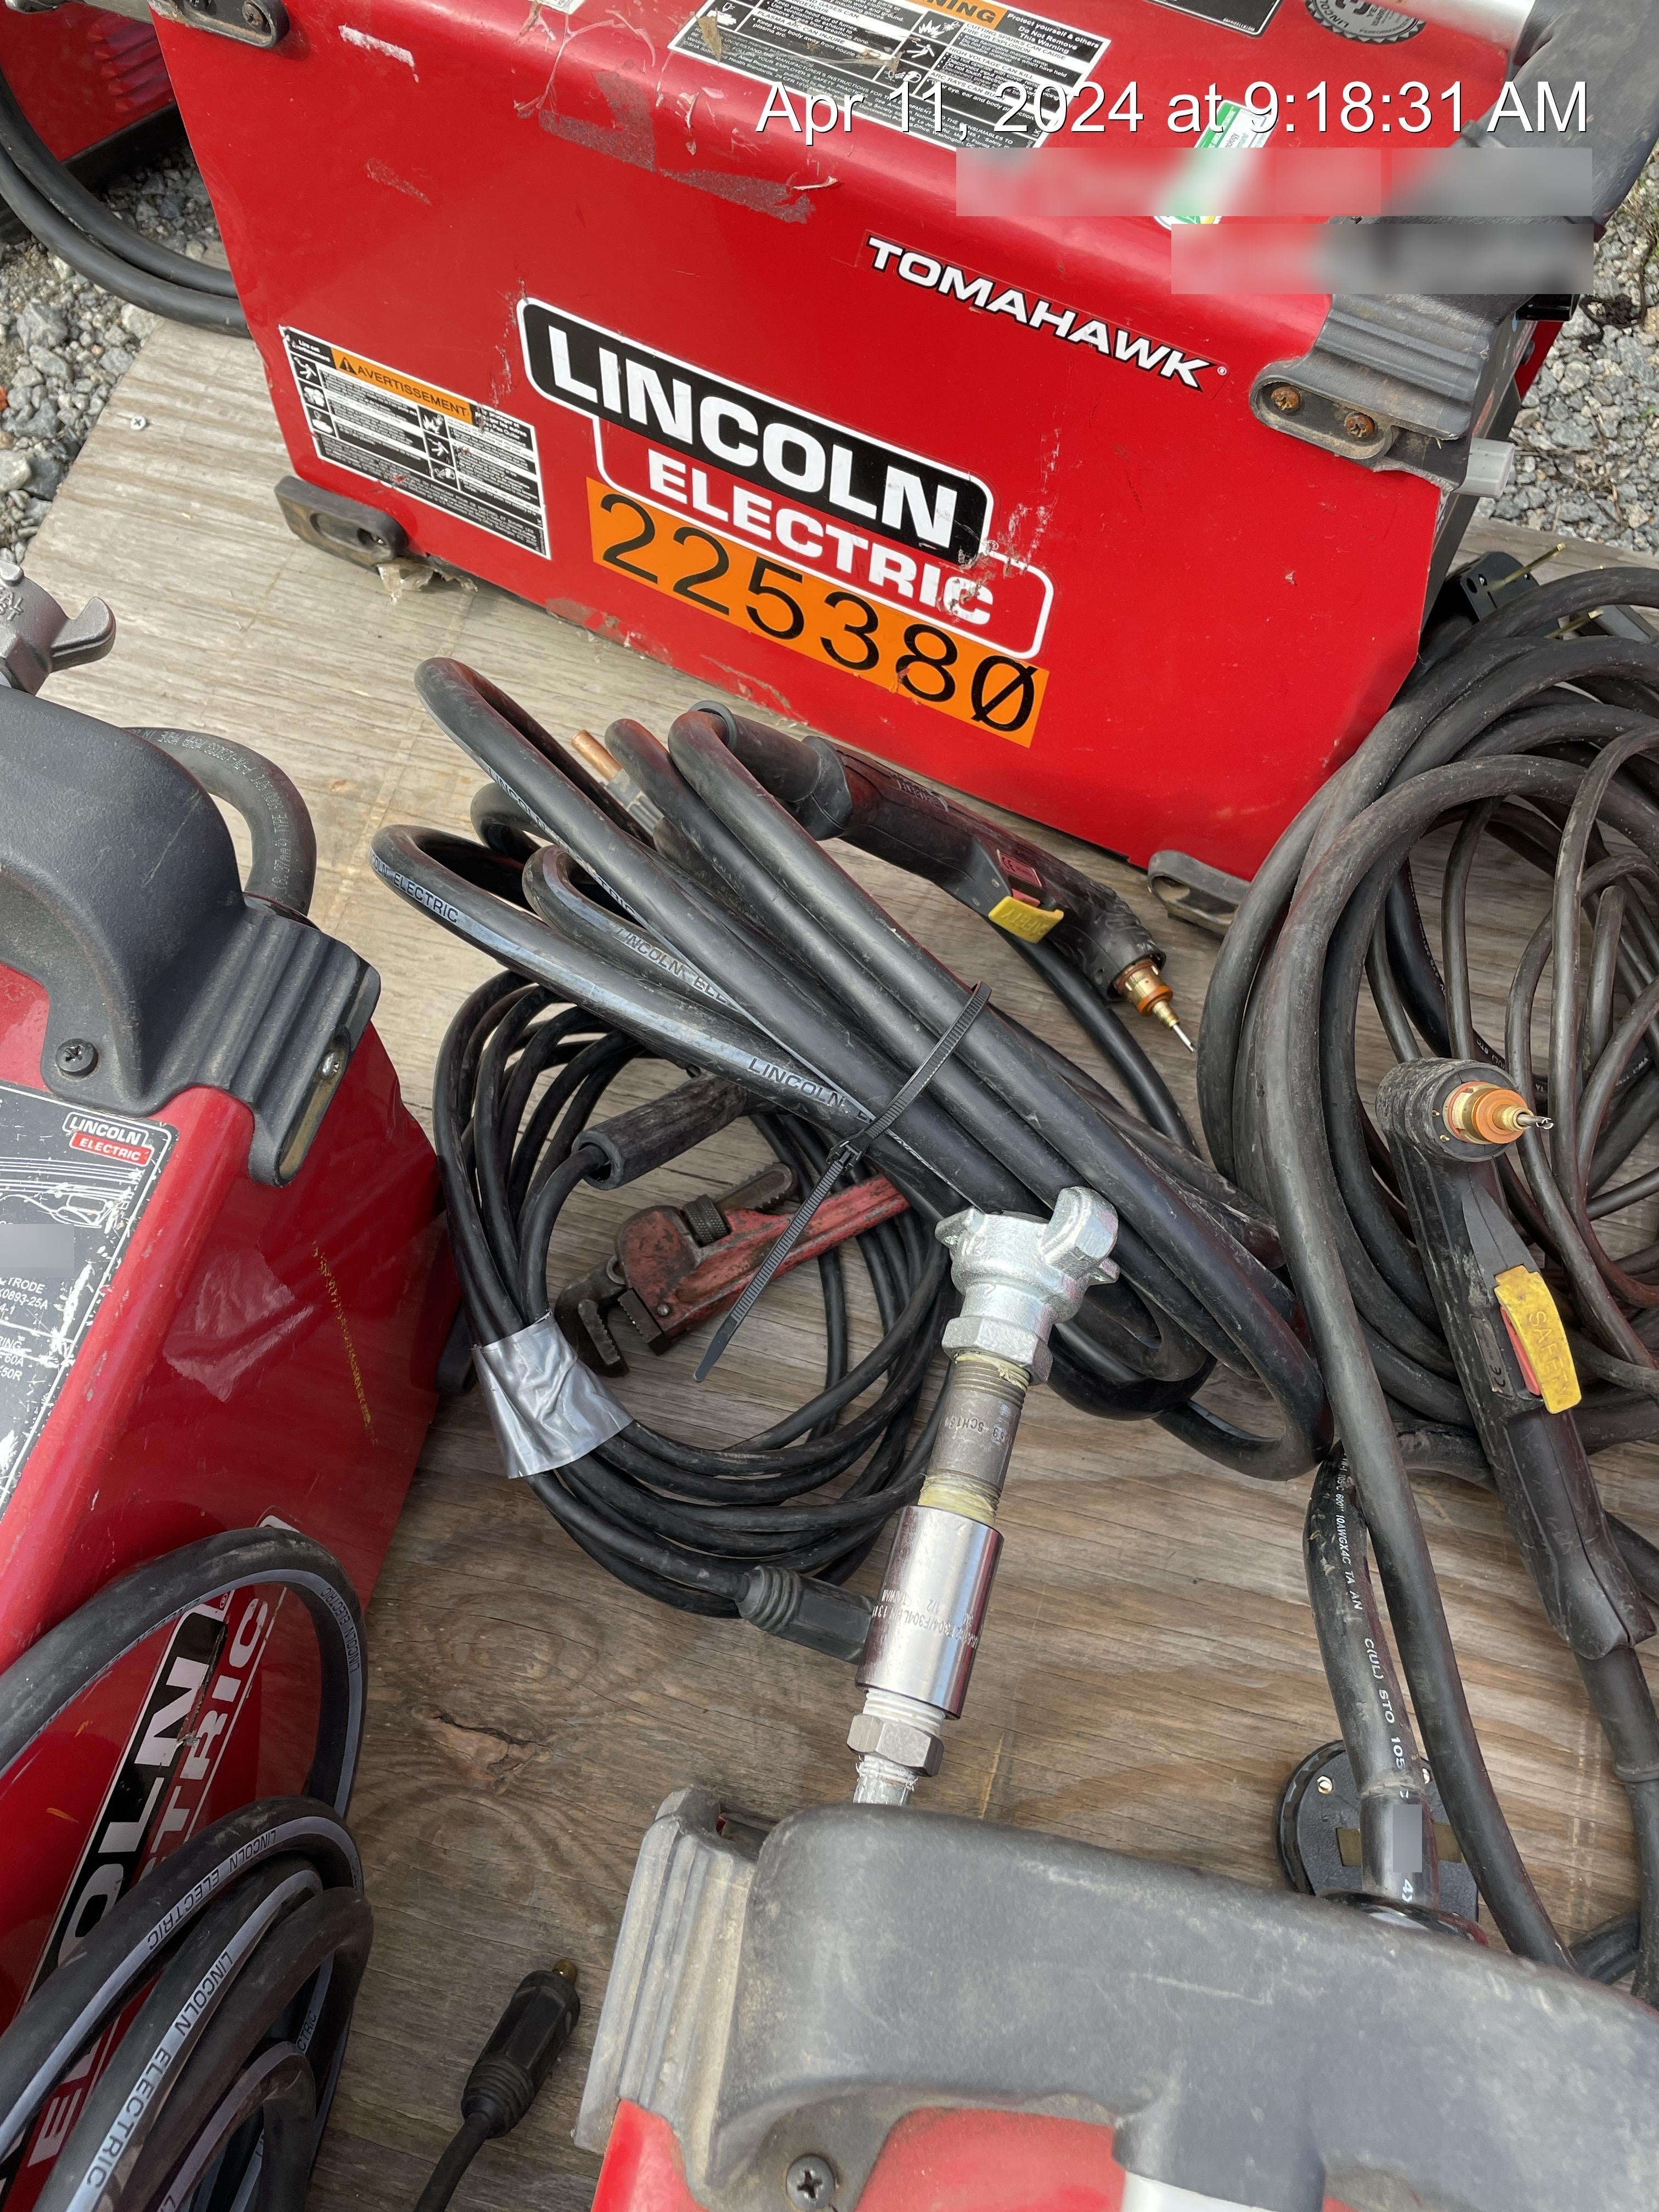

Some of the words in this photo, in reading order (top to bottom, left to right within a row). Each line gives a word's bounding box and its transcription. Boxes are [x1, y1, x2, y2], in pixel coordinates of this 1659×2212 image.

[752, 22, 775, 34] plasma
[757, 10, 786, 23] PLASMA
[802, 26, 818, 35] CAN
[819, 32, 844, 44] INJURE
[766, 5, 790, 16] remove
[823, 26, 853, 40] breathing
[788, 4, 804, 13] your
[804, 9, 821, 18] head
[821, 20, 845, 31] exhaust
[842, 10, 859, 19] CAN
[755, 19, 774, 28] Keep
[772, 25, 788, 33] your
[786, 30, 803, 39] body
[802, 36, 820, 45] away
[820, 41, 836, 49] from
[963, 35, 979, 43] Keep
[963, 27, 979, 35] FIRE
[991, 37, 1031, 53] EXPLOSION
[966, 22, 997, 36] CUTTING
[997, 33, 1025, 46] SPARKS
[1025, 43, 1041, 52] CAN
[1041, 49, 1066, 60] CAUSE
[1007, 12, 1036, 26] Protect
[1034, 22, 1066, 39] yourself
[1074, 36, 1100, 49] others
[1018, 32, 1036, 42] This
[1036, 39, 1070, 54] Warning
[1030, 30, 1046, 38] Not
[1045, 36, 1078, 50] Remove
[930, 71, 949, 81] ARC
[949, 78, 970, 88] RAYS
[949, 47, 968, 56] HIGH
[968, 53, 1001, 68] VOLTAGE
[1001, 65, 1018, 74] CAN
[1018, 71, 1034, 80] KILL
[826, 75, 870, 93] INSTRUCTIONS
[868, 236, 1212, 388] TOMAHAWK
[358, 365, 467, 417] AVERTISSEMENT
[549, 326, 956, 548] LINCOLN
[648, 449, 993, 624] ELECTRIC
[393, 871, 459, 924] ELECTRIC
[616, 927, 684, 976] LINCOLN
[747, 1058, 845, 1108] LINCOLN
[70, 1115, 143, 1146] LINCOLN
[78, 1137, 142, 1162] ELECTRIC
[1528, 1310, 1568, 1397] SAFETY
[320, 1587, 351, 1625] ELECTRIC
[343, 1627, 360, 1673] LINCOLN
[1378, 1688, 1395, 1724] STO
[1390, 1735, 1406, 1770] 105
[229, 1829, 276, 1870] LINCOLN
[147, 1871, 220, 1951] ELECTRIC
[174, 1950, 234, 2038] LINCOLN
[85, 2048, 172, 2189] ELECTRIC
